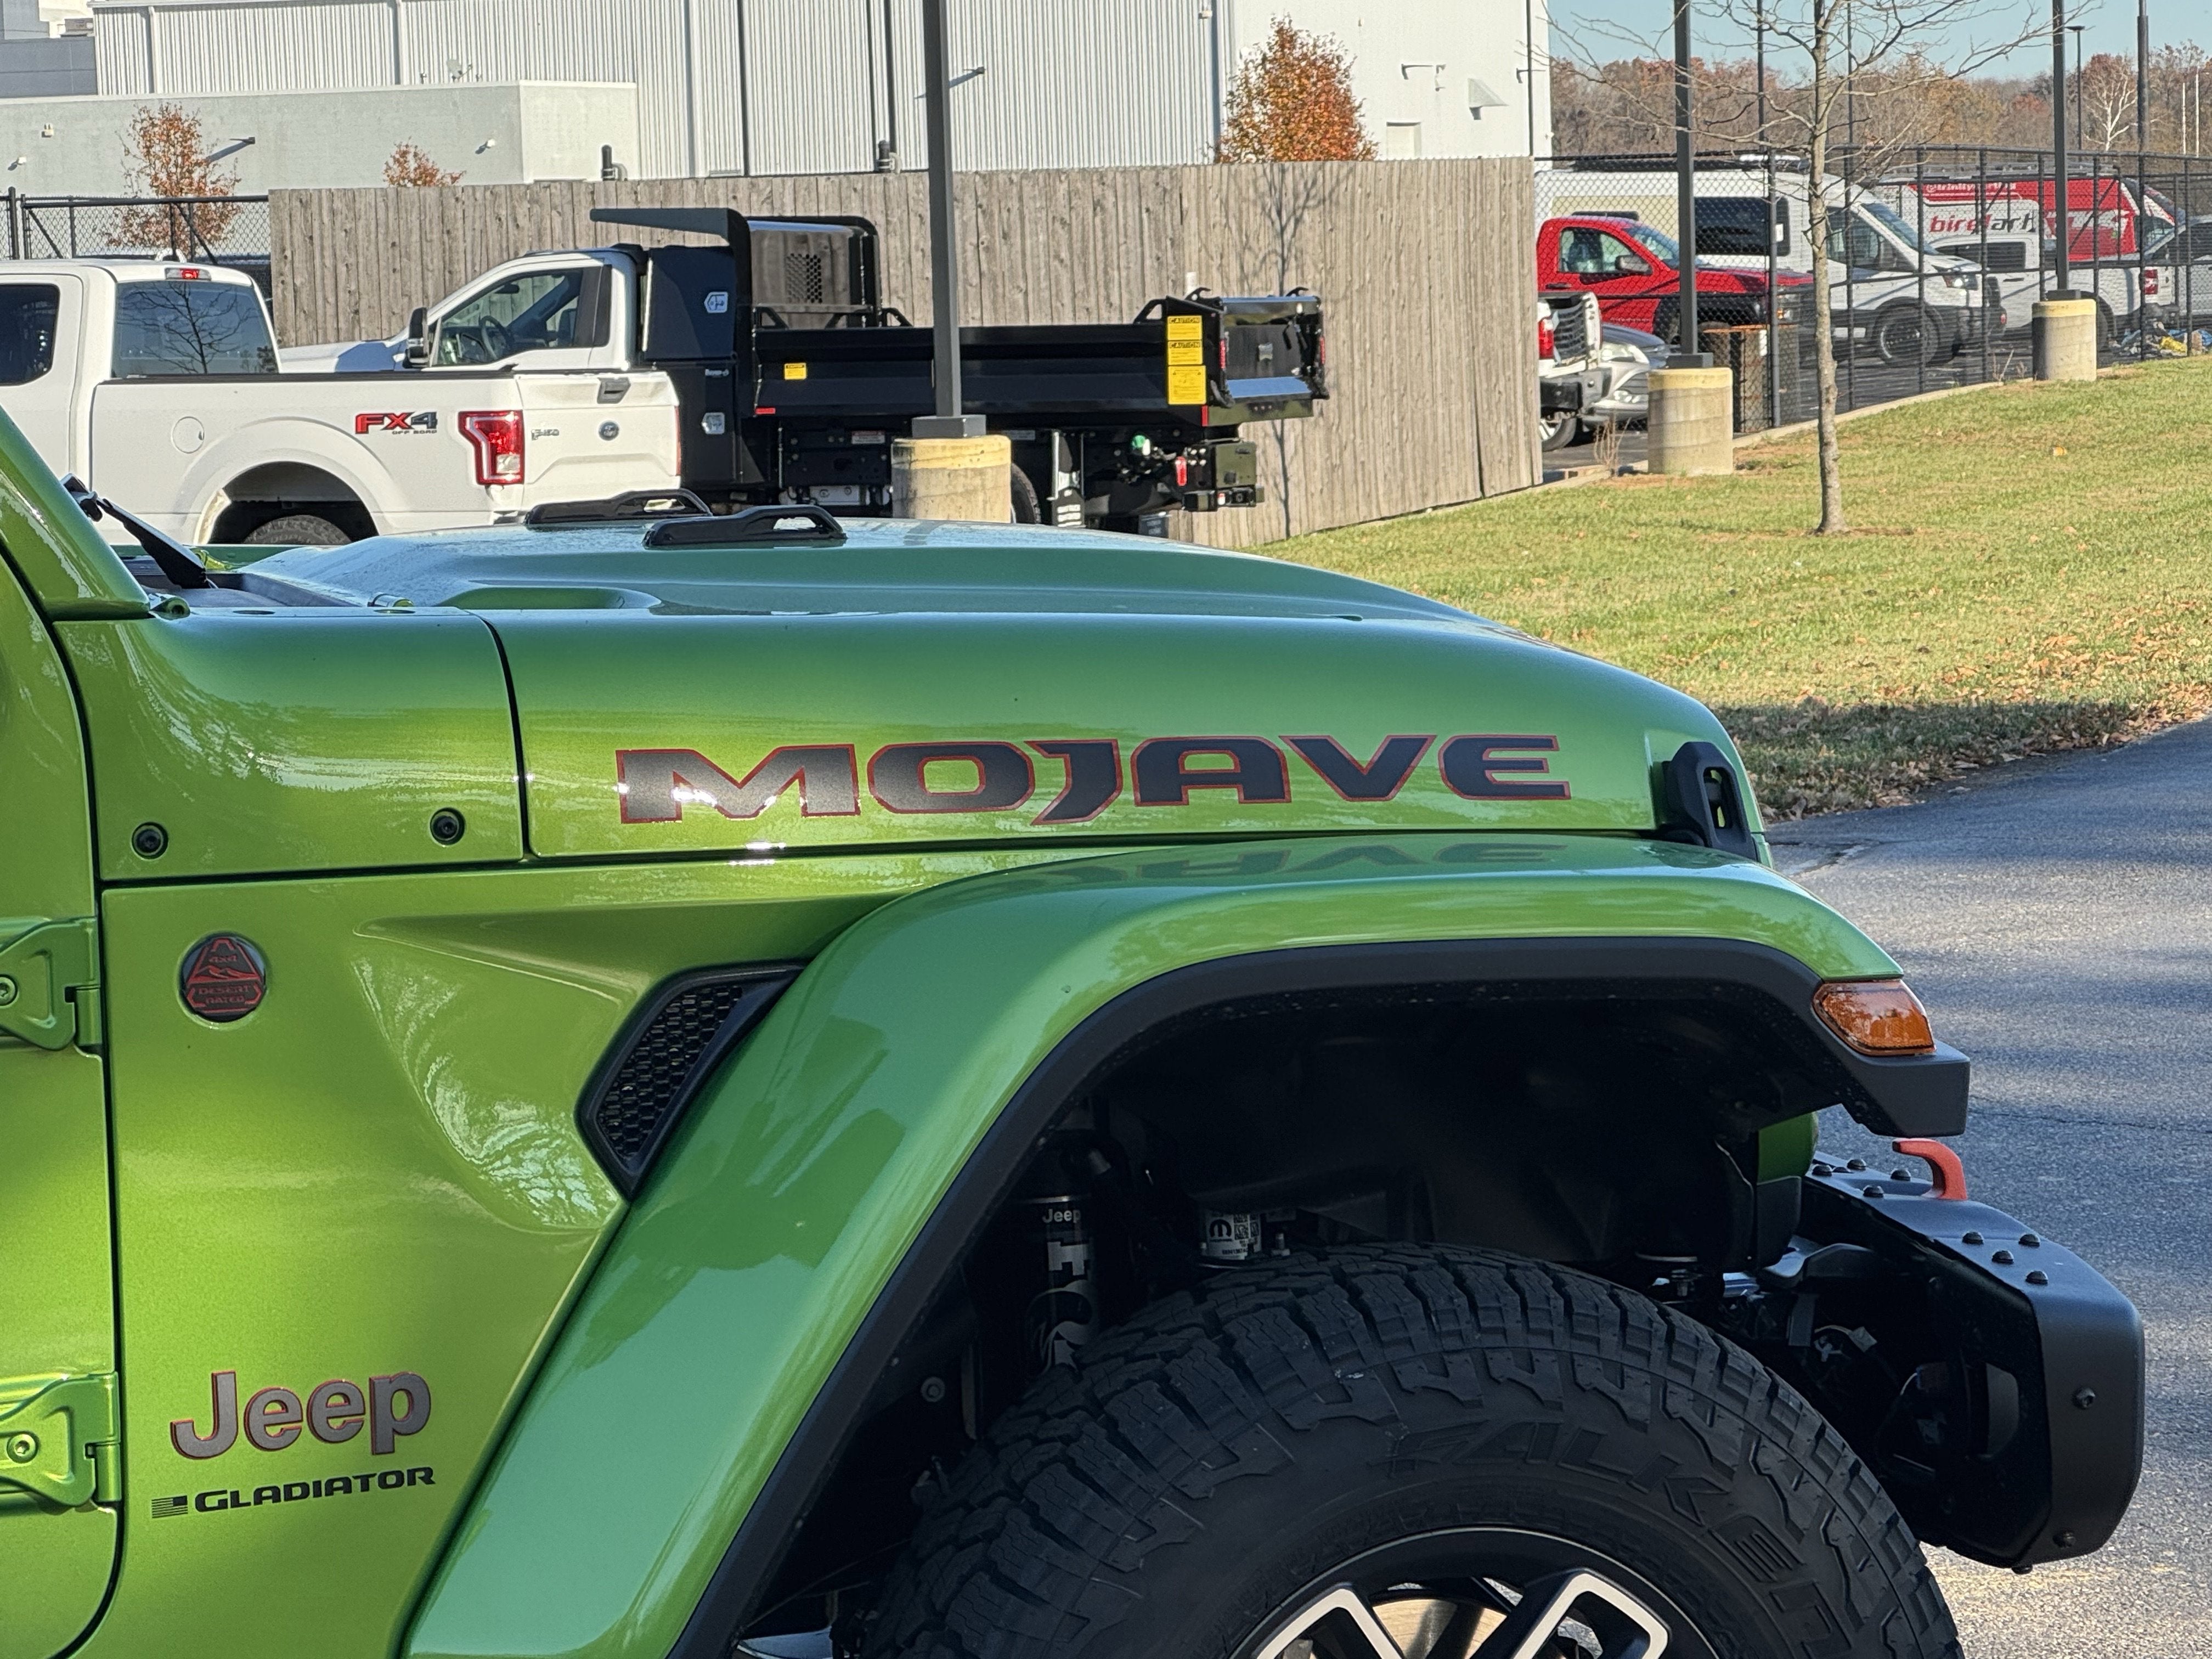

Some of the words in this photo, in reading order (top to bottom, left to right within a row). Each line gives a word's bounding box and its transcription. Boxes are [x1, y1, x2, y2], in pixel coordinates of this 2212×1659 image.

[355, 411, 438, 435] FX4
[616, 733, 1572, 825] MOJAVE
[199, 985, 250, 995] DESERT
[1041, 1208, 1081, 1223] Jeep
[170, 1370, 432, 1459] Jeep
[194, 1466, 436, 1513] GLADIATOR
